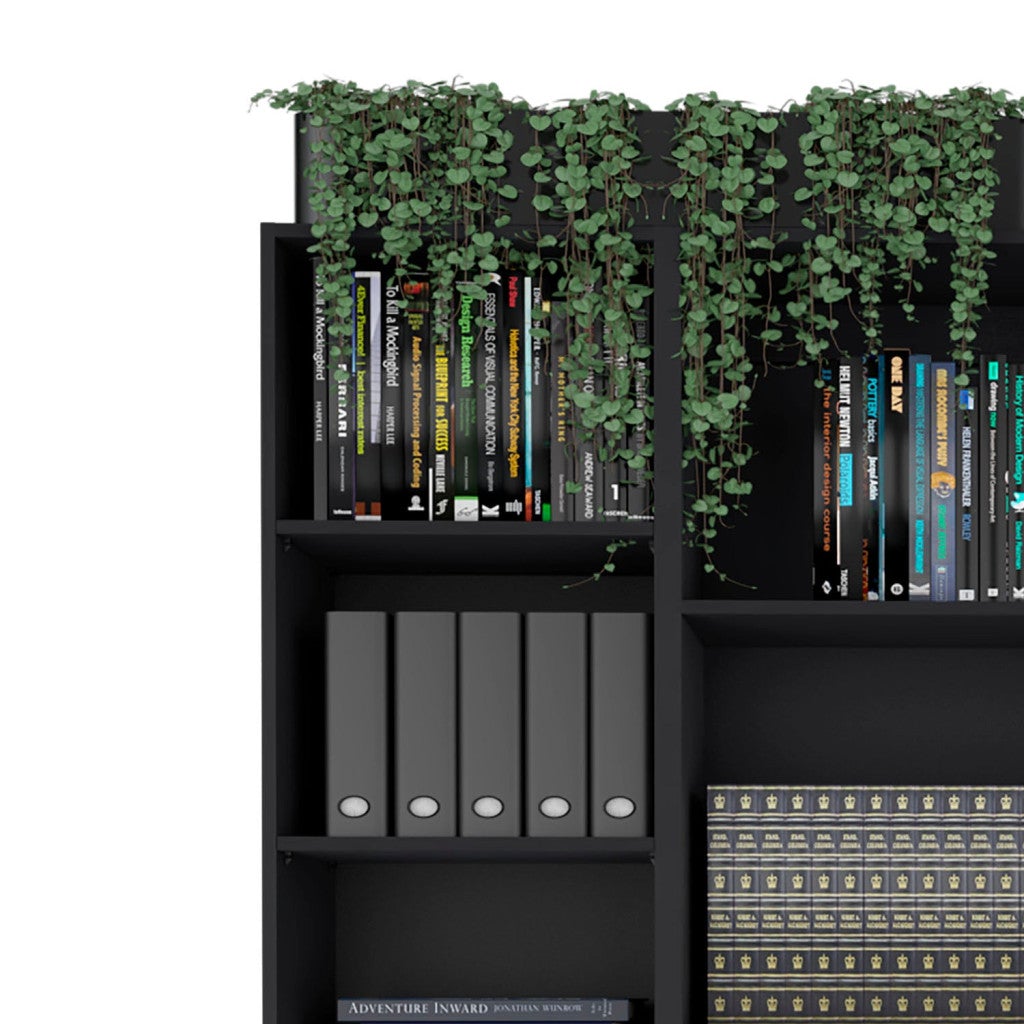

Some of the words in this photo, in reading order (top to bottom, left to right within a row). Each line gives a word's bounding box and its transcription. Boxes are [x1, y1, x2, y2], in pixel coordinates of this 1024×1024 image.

[386, 285, 398, 298] To
[386, 300, 398, 314] Kill
[459, 296, 473, 333] Design
[383, 325, 398, 387] Mockingbird
[412, 337, 422, 361] Audio
[461, 337, 473, 387] Research
[509, 359, 519, 370] and
[891, 356, 902, 383] ONE
[410, 363, 422, 389] Signal
[436, 357, 448, 402] BLUEPRINT
[509, 372, 519, 382] the
[840, 366, 850, 403] HELMUT
[509, 384, 519, 396] New
[868, 378, 877, 417] POTTERY
[891, 386, 902, 413] DAY
[988, 382, 997, 411] drawing
[1014, 375, 1024, 405] History
[410, 392, 422, 437] Processing
[509, 398, 519, 412] York
[386, 407, 394, 430] HARPER
[508, 414, 519, 426] City
[840, 407, 850, 447] NEWTON
[386, 432, 394, 445] LEE
[436, 419, 448, 451] SUCCESS
[508, 428, 519, 452] Subway
[823, 412, 831, 458] interior
[867, 420, 876, 443] basics
[1016, 419, 1024, 458] Modern
[412, 439, 422, 456] and
[410, 458, 422, 488] Coding
[436, 454, 445, 476] NEVILLE
[508, 454, 519, 477] System
[1014, 460, 1024, 484] Design
[436, 478, 445, 492] LAKE
[822, 463, 831, 505] design
[349, 1002, 429, 1014] ADVENTURE
[434, 1002, 488, 1014] INWARD
